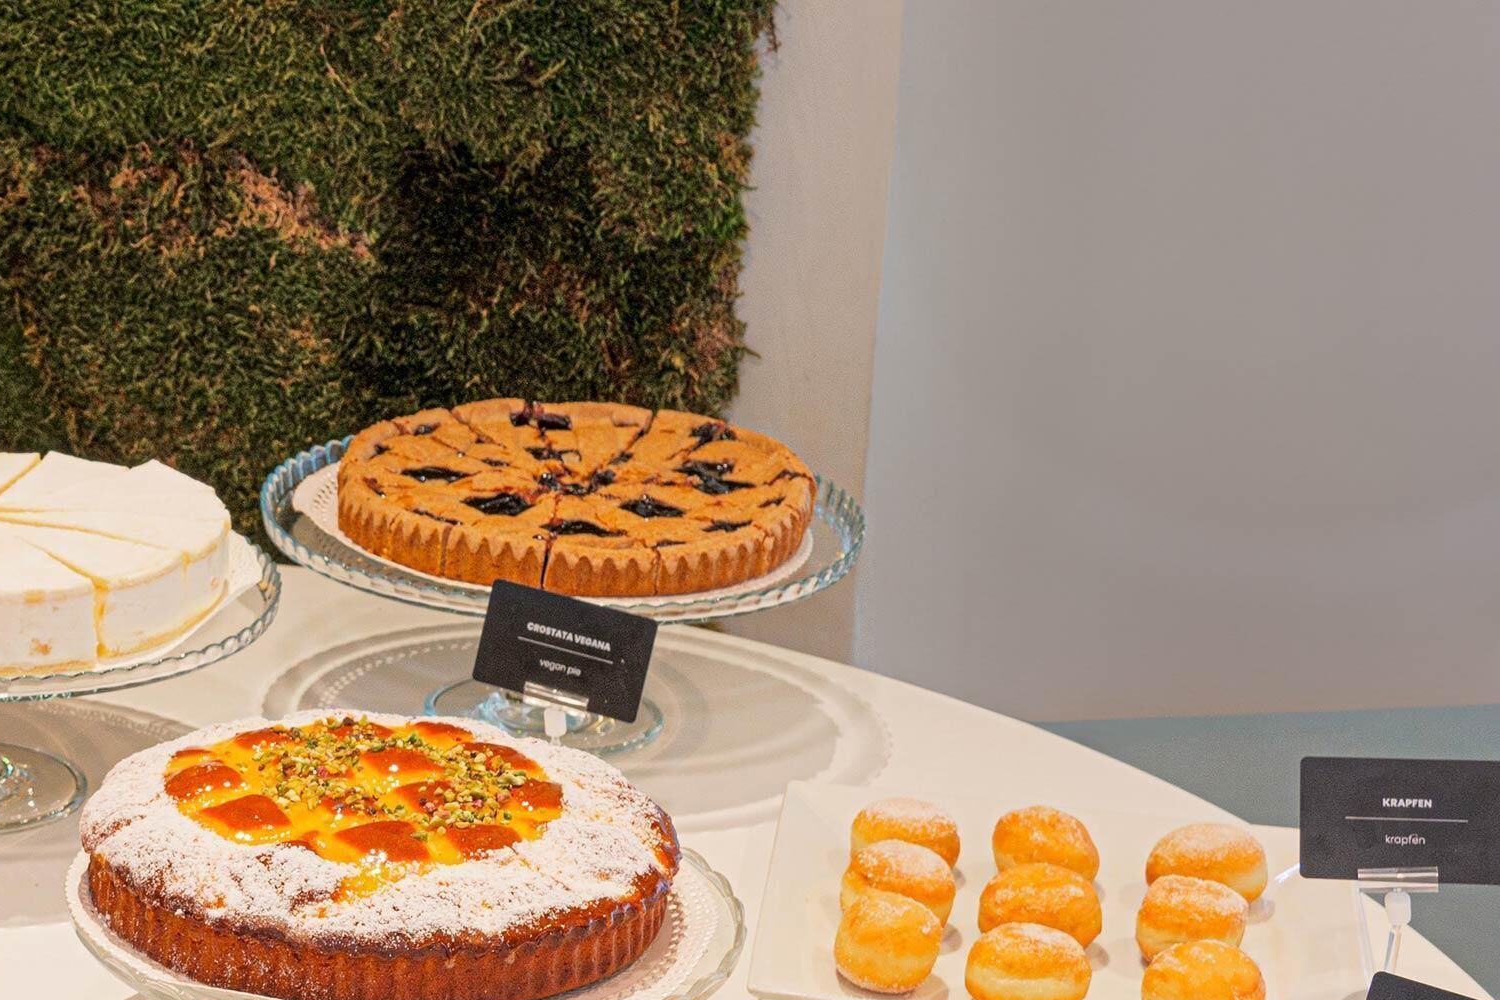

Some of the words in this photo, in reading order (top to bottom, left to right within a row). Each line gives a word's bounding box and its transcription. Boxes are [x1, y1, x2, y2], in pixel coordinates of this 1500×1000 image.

[526, 621, 574, 642] CROSTATA
[574, 633, 611, 652] VEGANA
[539, 659, 566, 673] vegan
[566, 666, 582, 678] pie
[1382, 797, 1433, 809] KRAPFEN
